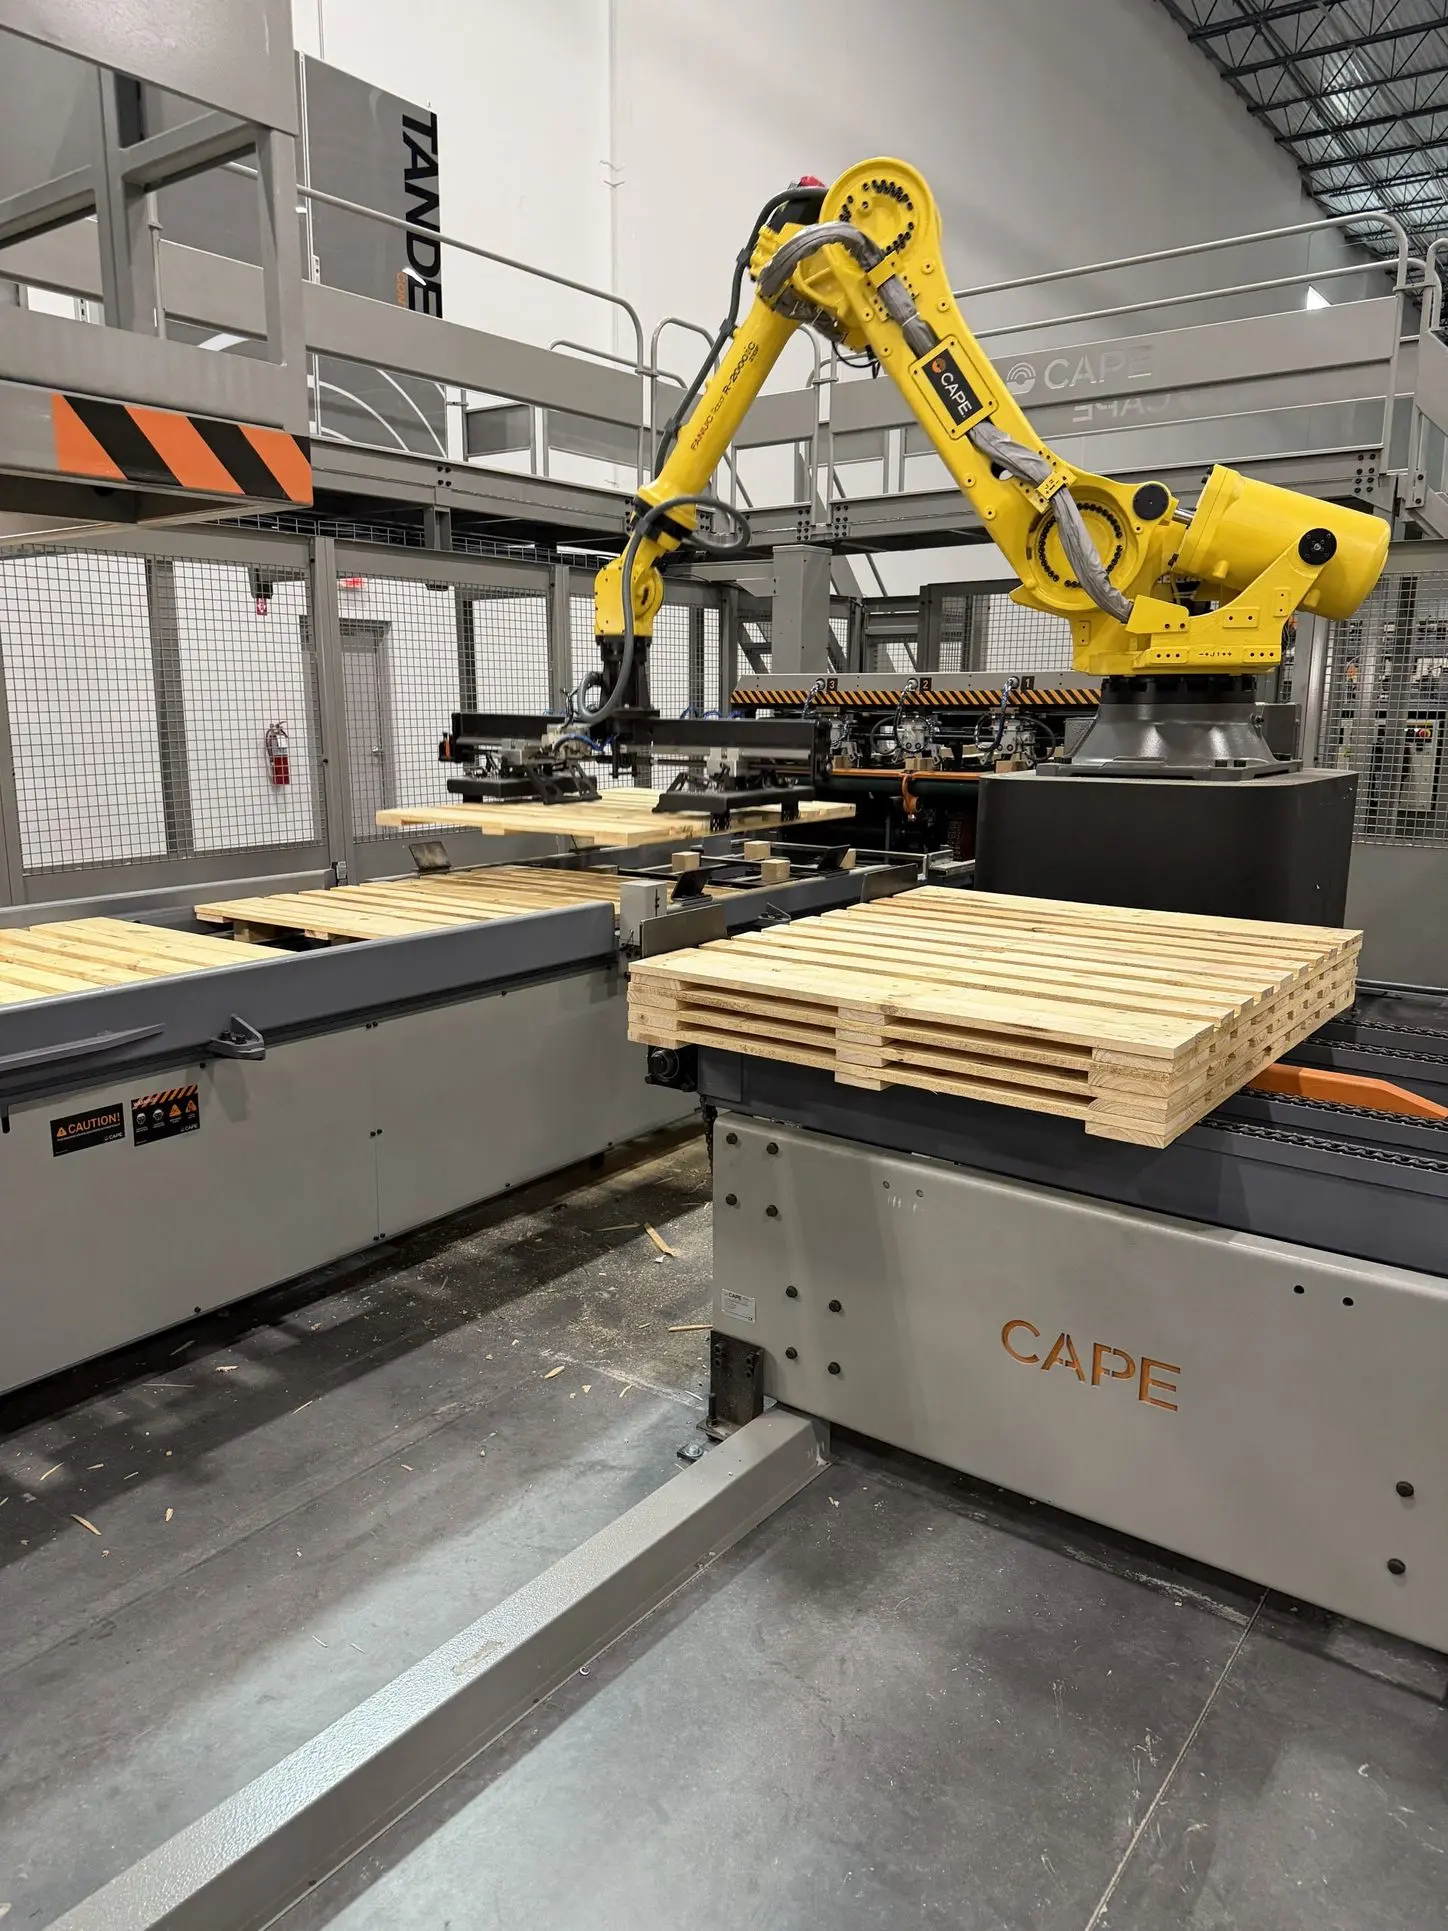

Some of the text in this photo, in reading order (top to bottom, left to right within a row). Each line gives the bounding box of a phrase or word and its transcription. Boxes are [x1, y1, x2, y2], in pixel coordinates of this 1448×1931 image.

[1044, 345, 1154, 390] CAPE
[940, 372, 973, 416] CAPE
[691, 414, 714, 450] FANUC
[829, 680, 836, 690] 3
[921, 679, 929, 689] 2
[1025, 677, 1031, 688] 1
[68, 1112, 121, 1134] CAUTION!
[1001, 1319, 1181, 1412] CAPE
